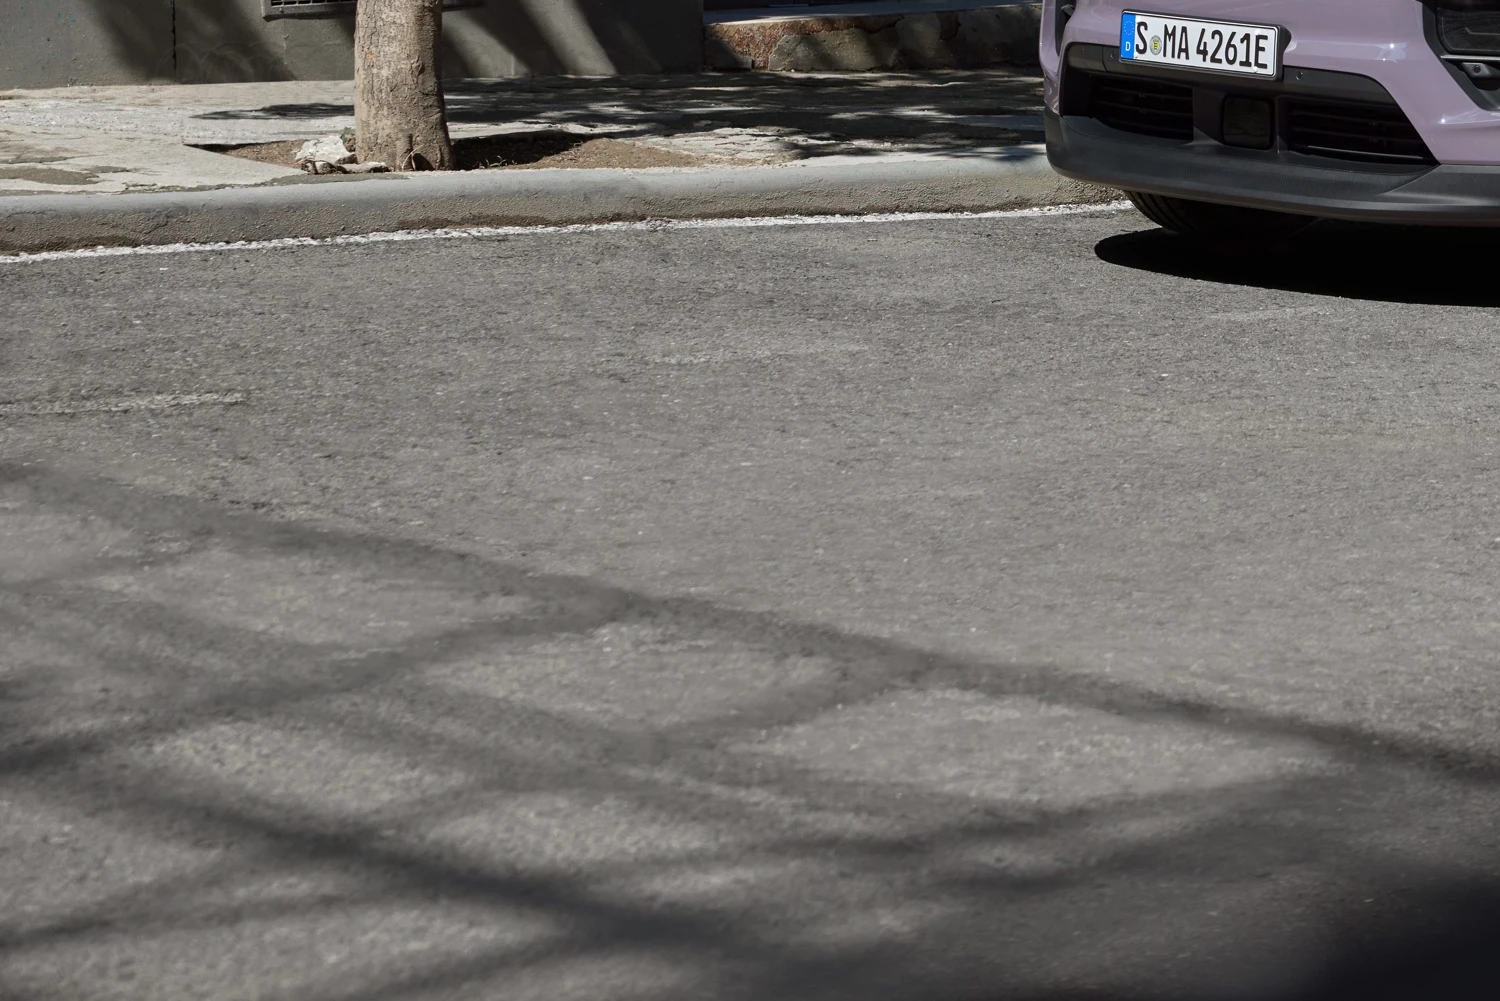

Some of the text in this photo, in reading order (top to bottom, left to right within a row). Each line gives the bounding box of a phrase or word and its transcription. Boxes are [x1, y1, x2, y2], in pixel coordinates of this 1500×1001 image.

[1125, 41, 1131, 51] D
[1135, 21, 1269, 69] S MA 4261E
